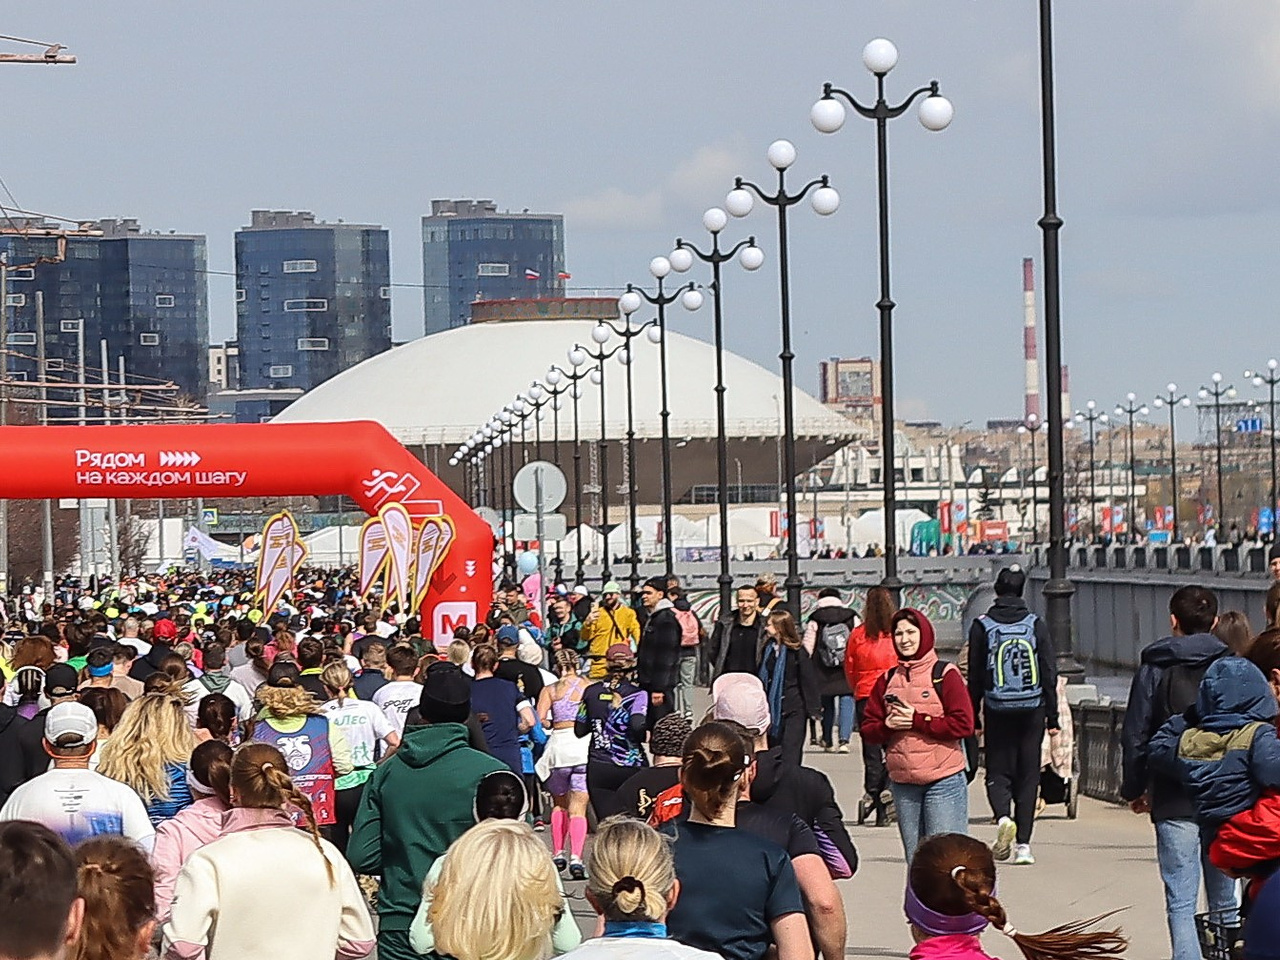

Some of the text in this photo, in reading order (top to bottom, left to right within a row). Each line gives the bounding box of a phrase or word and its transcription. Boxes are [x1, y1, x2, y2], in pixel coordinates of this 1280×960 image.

[75, 450, 145, 469] Рядом
[76, 471, 247, 487] на каждом шагу
